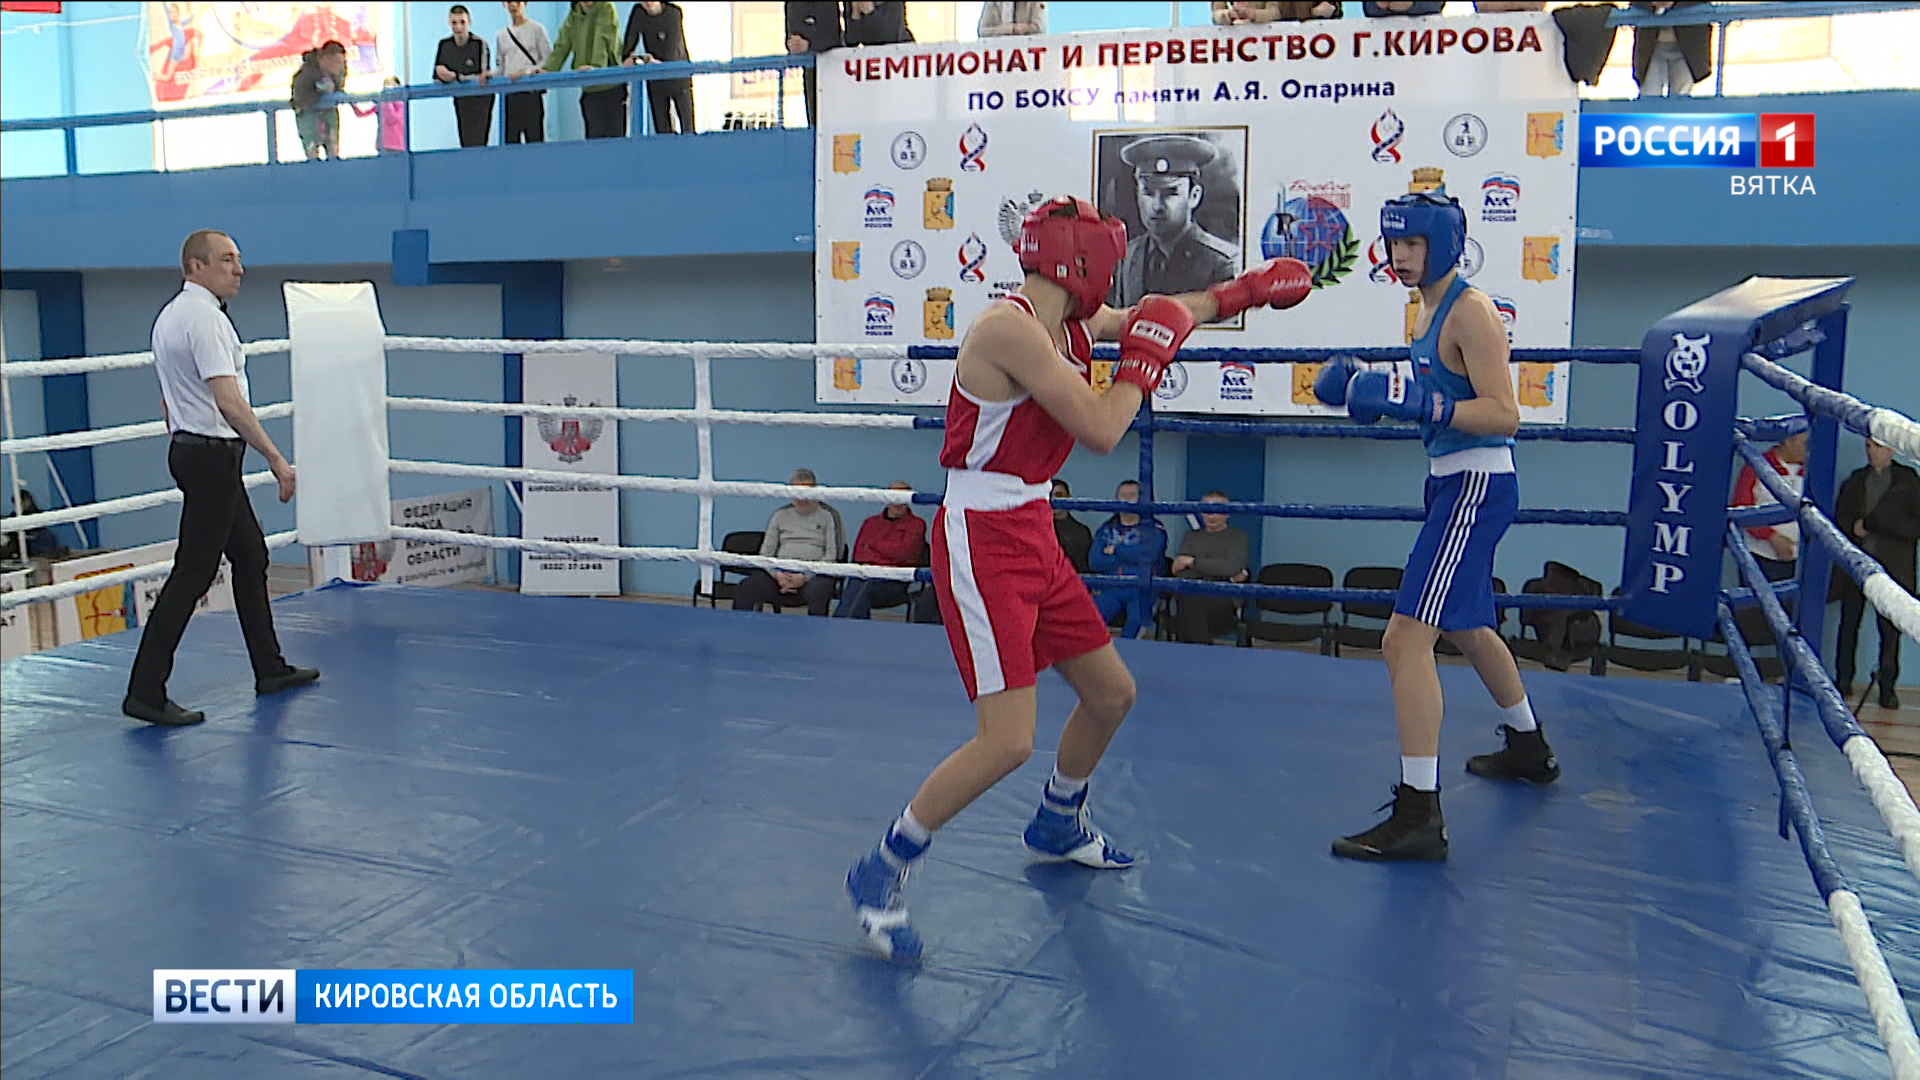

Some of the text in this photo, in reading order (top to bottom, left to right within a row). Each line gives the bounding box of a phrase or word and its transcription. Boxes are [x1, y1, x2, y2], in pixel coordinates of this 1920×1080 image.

[844, 25, 1543, 82] ЧЕМПИОНАТ И ПЕРВЕНСТВО Г.КИРОВА
[968, 78, 1395, 111] ПО БОКСУ памяти А.Я. Опарина
[1649, 400, 1698, 595] OLYMP
